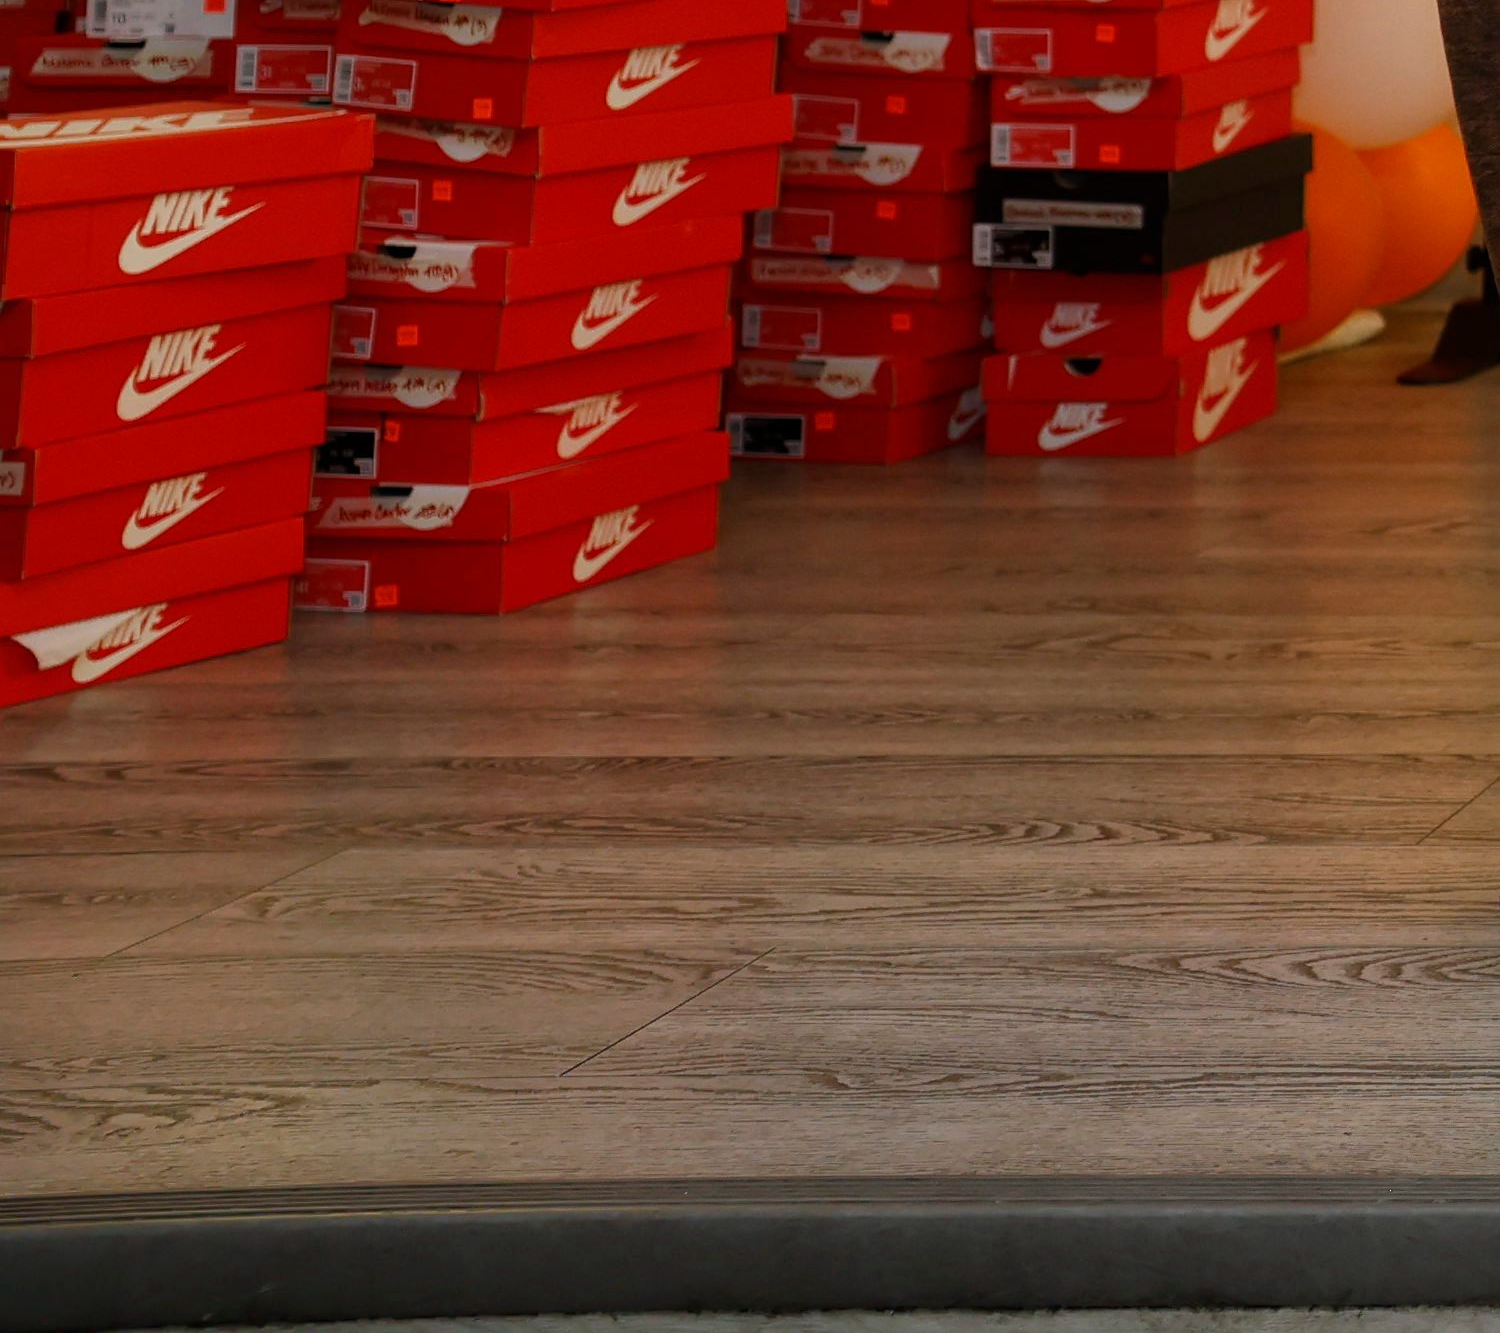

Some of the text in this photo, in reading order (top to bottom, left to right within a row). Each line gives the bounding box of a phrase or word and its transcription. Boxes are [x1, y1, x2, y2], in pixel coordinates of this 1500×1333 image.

[620, 43, 685, 81] NIKE
[628, 156, 690, 198] NIKE
[141, 185, 235, 235] NIKE
[584, 278, 644, 321] NIKE
[136, 323, 222, 383] NIKE
[1052, 401, 1110, 435] NIKE
[139, 471, 207, 520] NIKE
[584, 504, 642, 552] NIKE
